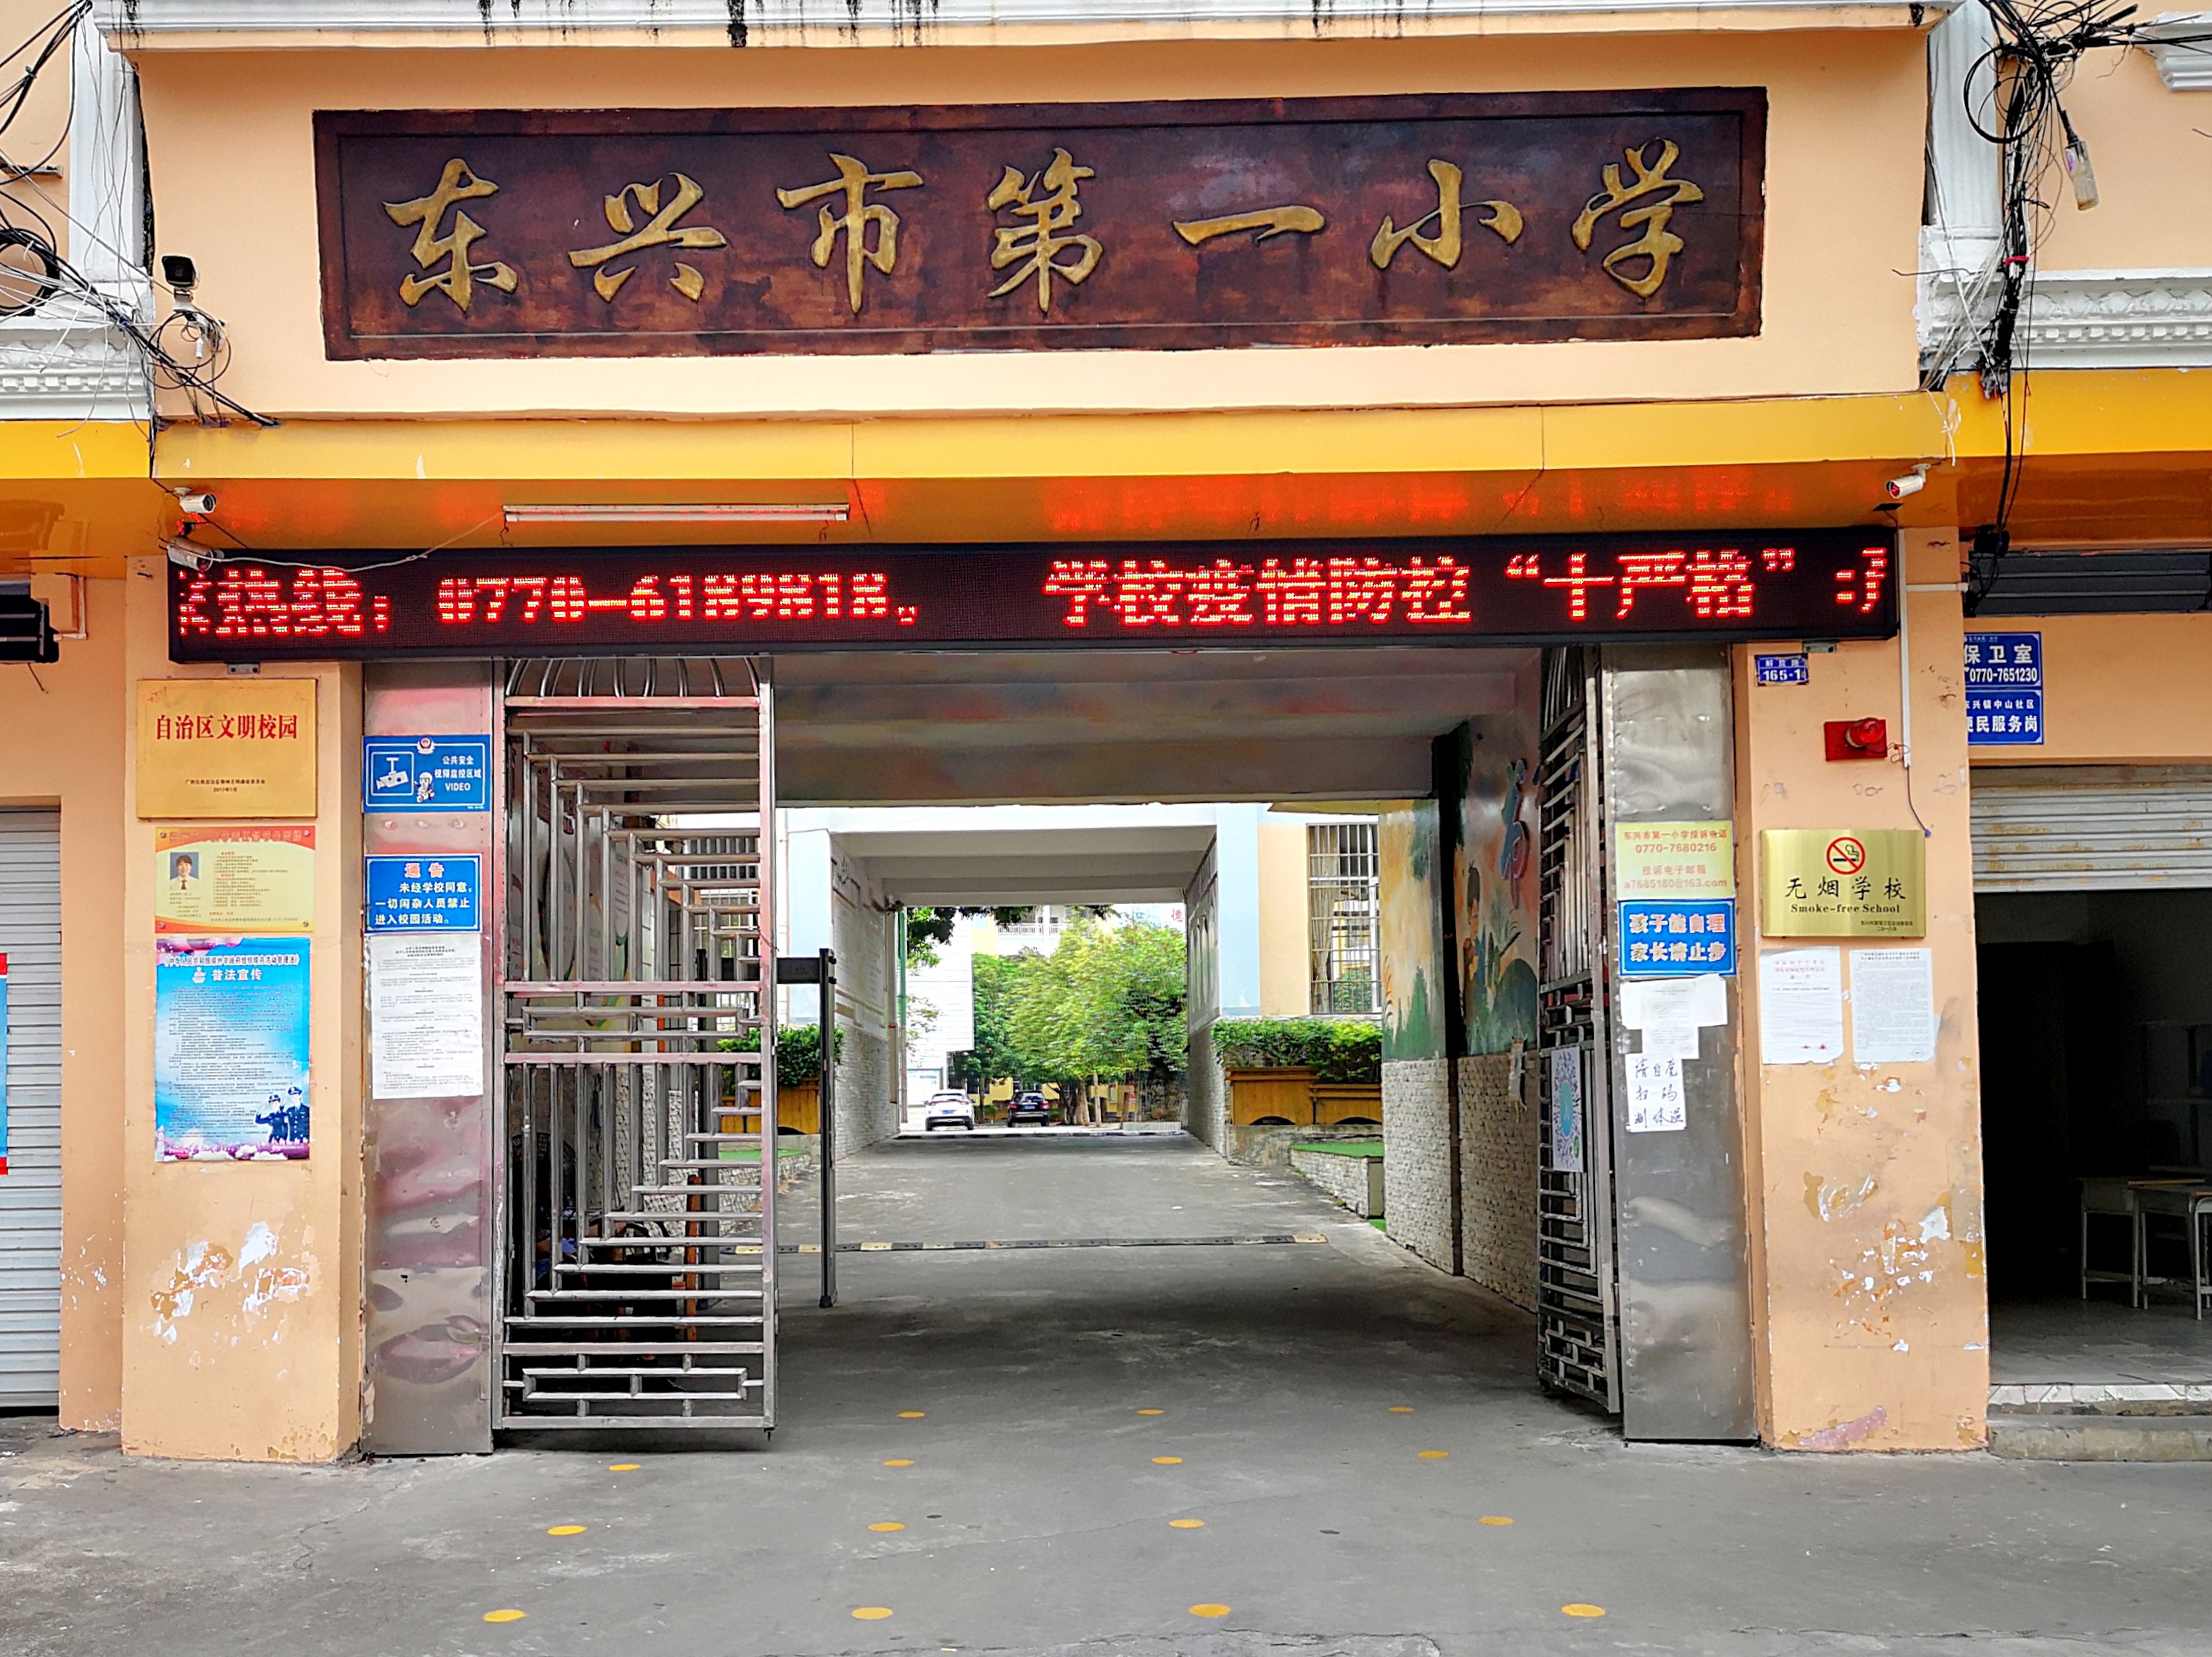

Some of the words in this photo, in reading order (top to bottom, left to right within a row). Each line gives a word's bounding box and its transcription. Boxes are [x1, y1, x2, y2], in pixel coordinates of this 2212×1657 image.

[384, 138, 1704, 313] 东兴市第一小学
[1964, 644, 2033, 665] 保卫室
[1970, 668, 2037, 682] 0770-7651230
[156, 714, 297, 740] 自治区文明校园
[442, 755, 474, 765] 公共安全
[434, 769, 482, 778] 视频监控区域
[445, 783, 471, 791] VIDEO
[1624, 829, 1727, 841] 东兴市第一小学投诉电话
[1636, 842, 1717, 853] 0770-7680216
[404, 862, 445, 878] 通告
[1642, 865, 1706, 875] 投诉电子邮箱
[1785, 876, 1906, 900] 无烟学校
[375, 897, 470, 909] 一切闲杂人员禁止
[1791, 904, 1860, 913] Smoke-free
[1863, 904, 1900, 913] School
[375, 913, 449, 925] 进入校园活动。
[1629, 914, 1726, 933] 孩子能自理
[1631, 941, 1726, 961] 家长请止步
[211, 968, 262, 981] 普法宣传
